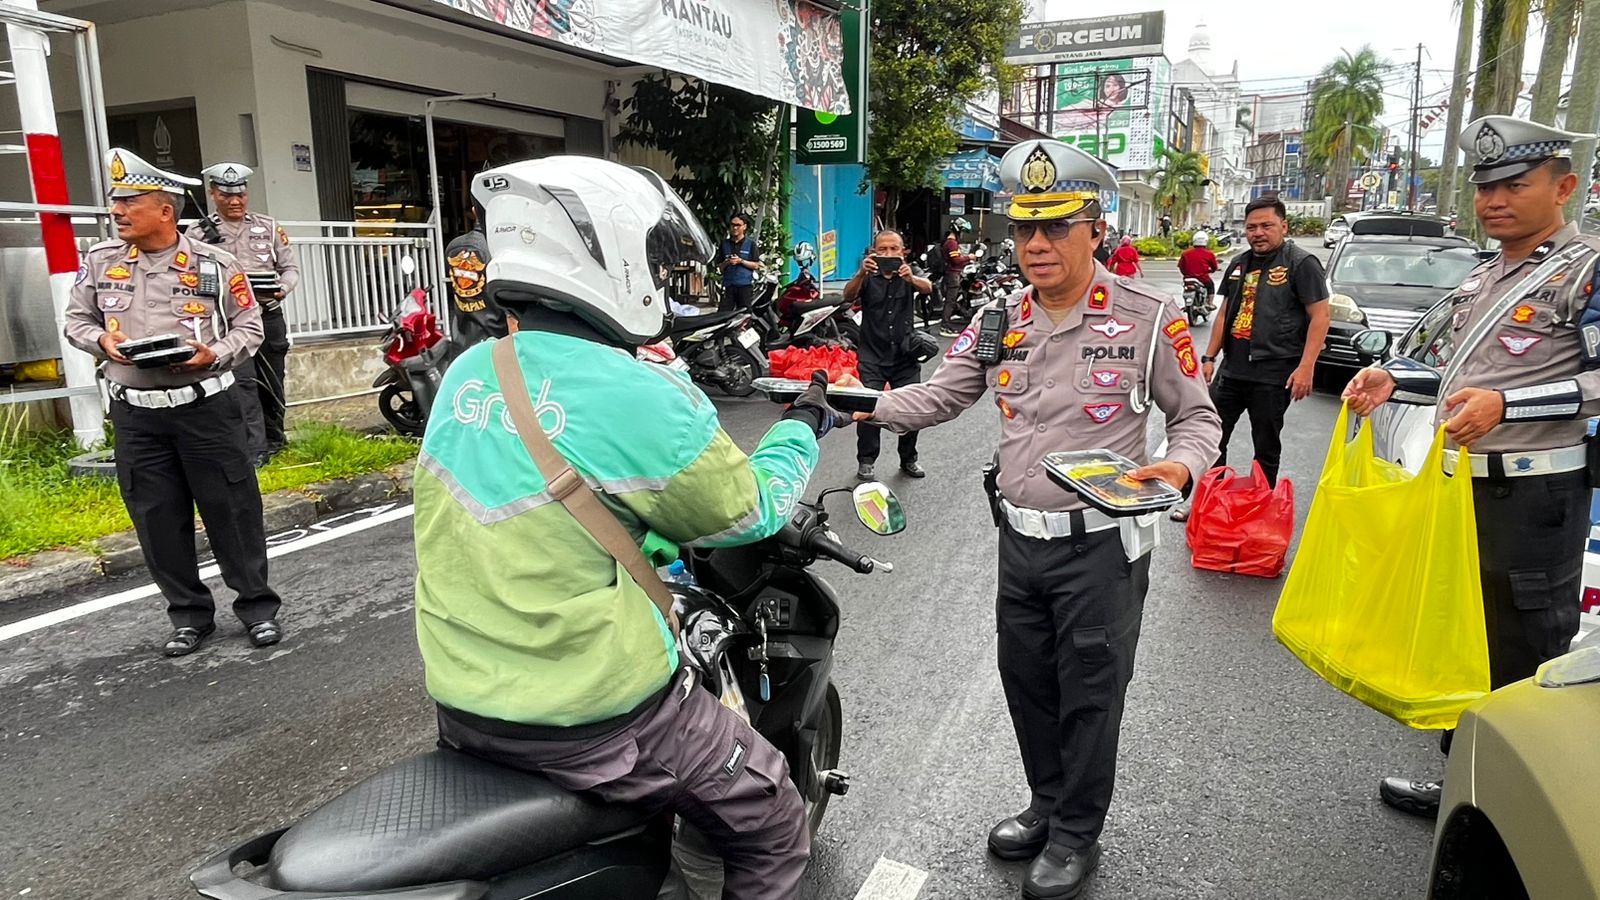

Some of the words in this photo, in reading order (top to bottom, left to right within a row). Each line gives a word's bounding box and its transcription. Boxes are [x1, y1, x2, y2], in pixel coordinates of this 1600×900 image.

[661, 0, 732, 39] MANTAU
[1019, 24, 1142, 52] FORCEUM
[813, 141, 830, 149] 1500
[830, 140, 844, 148] 569
[1081, 345, 1135, 360] POLRI
